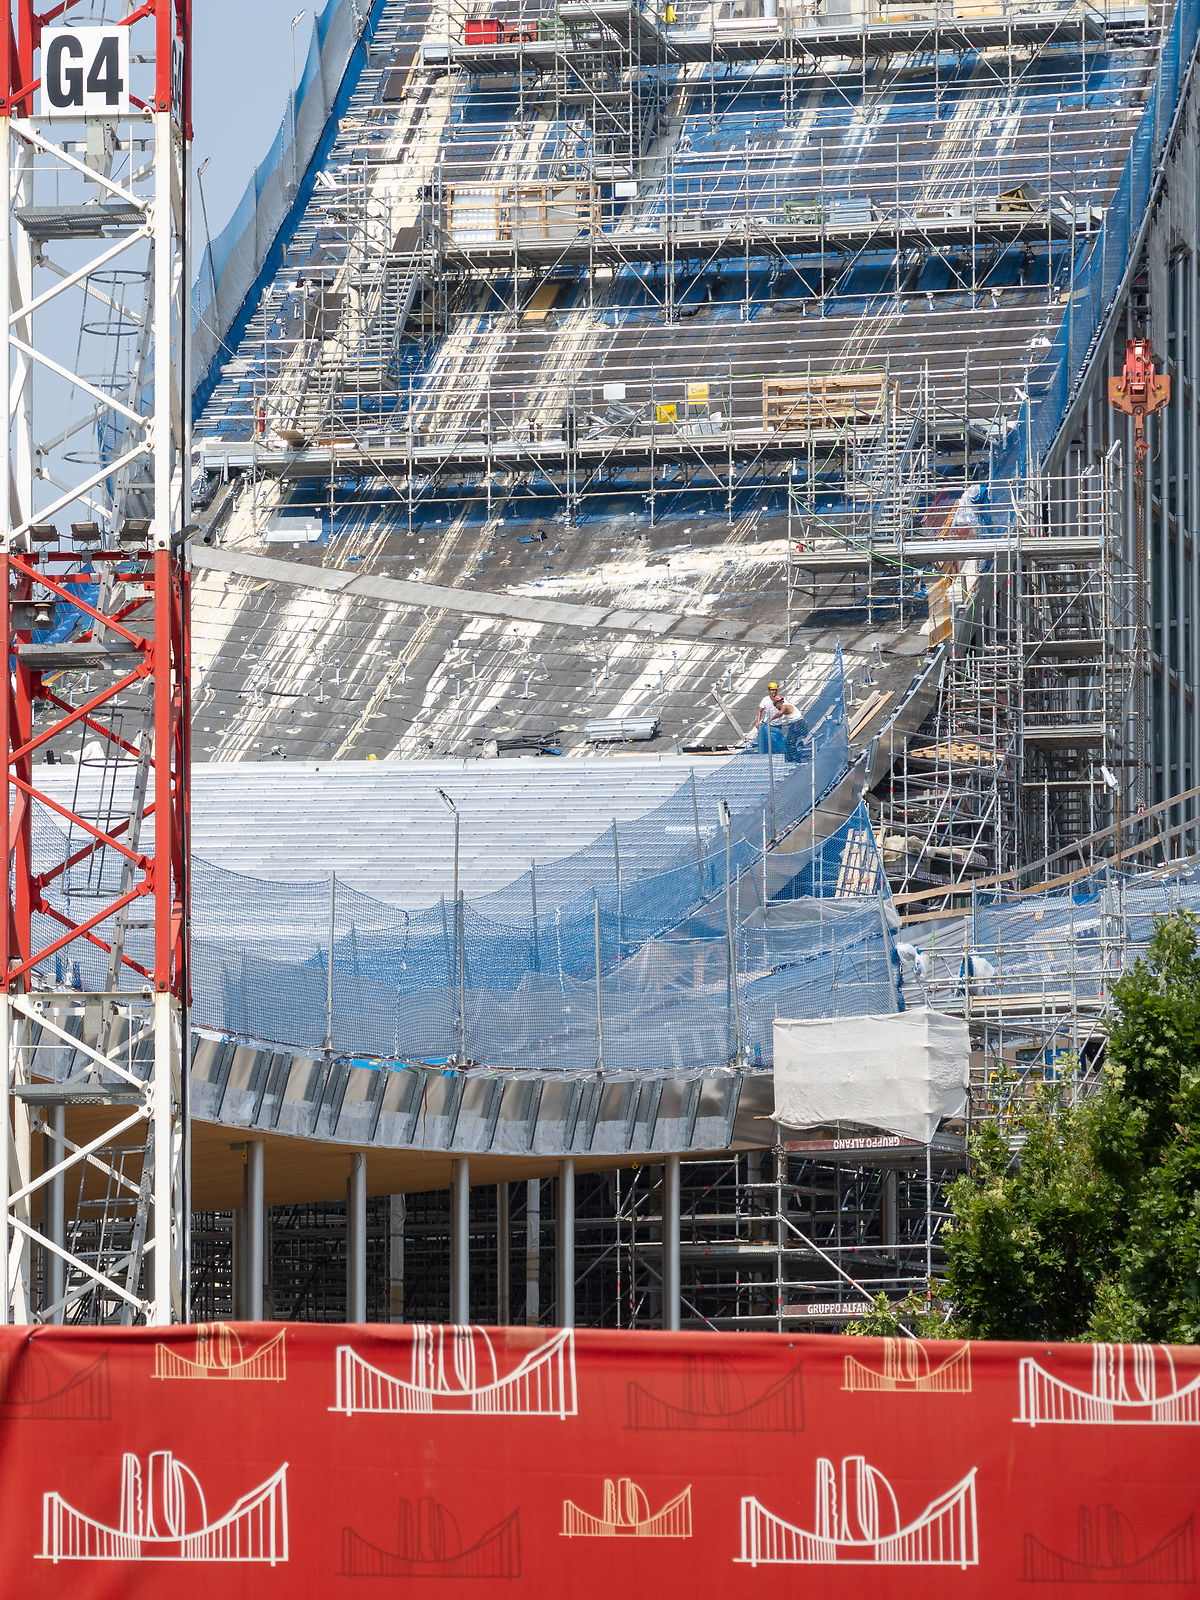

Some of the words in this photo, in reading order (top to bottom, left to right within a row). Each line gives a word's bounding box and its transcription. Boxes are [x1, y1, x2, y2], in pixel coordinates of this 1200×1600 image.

[47, 34, 124, 108] G4
[833, 1138, 865, 1150] ALFANO
[866, 1136, 900, 1148] GRUPPO
[807, 1303, 841, 1314] GRUPPO
